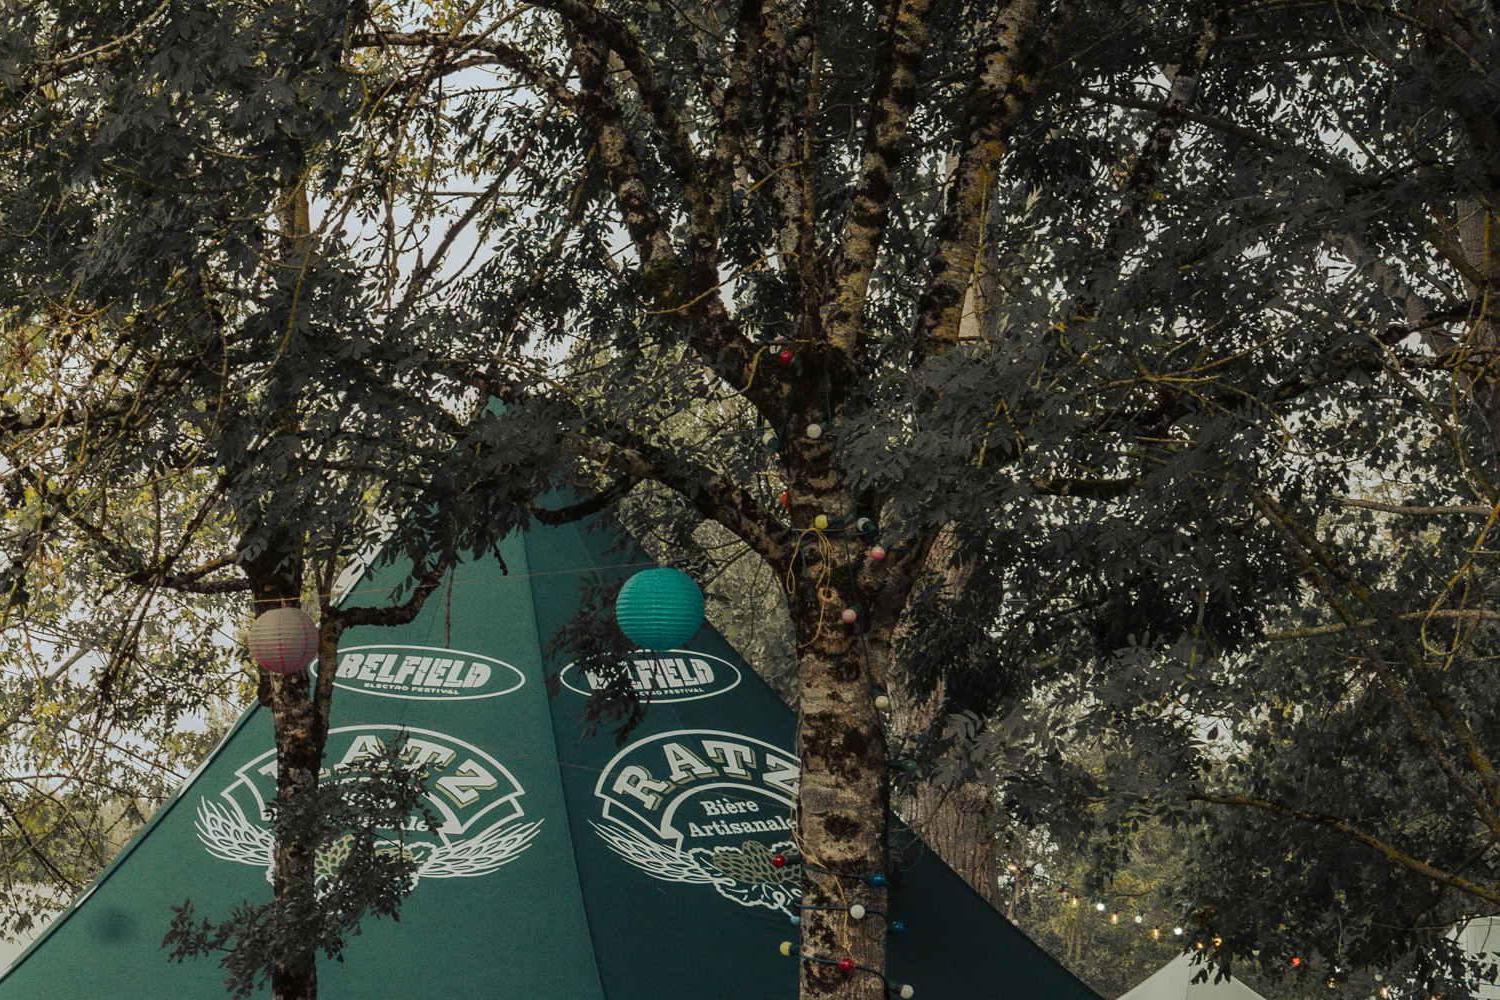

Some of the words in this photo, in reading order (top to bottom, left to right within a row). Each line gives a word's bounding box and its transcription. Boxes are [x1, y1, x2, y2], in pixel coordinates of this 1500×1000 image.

[334, 653, 492, 688] BELFIELD
[363, 681, 409, 692] ELECTRO
[410, 686, 460, 695] FESTIVAL
[664, 687, 705, 696] FESTIVAL
[257, 735, 499, 809] ATZ
[612, 739, 801, 812] RATZ
[699, 798, 760, 817] Bière
[688, 815, 798, 838] Artisanale
